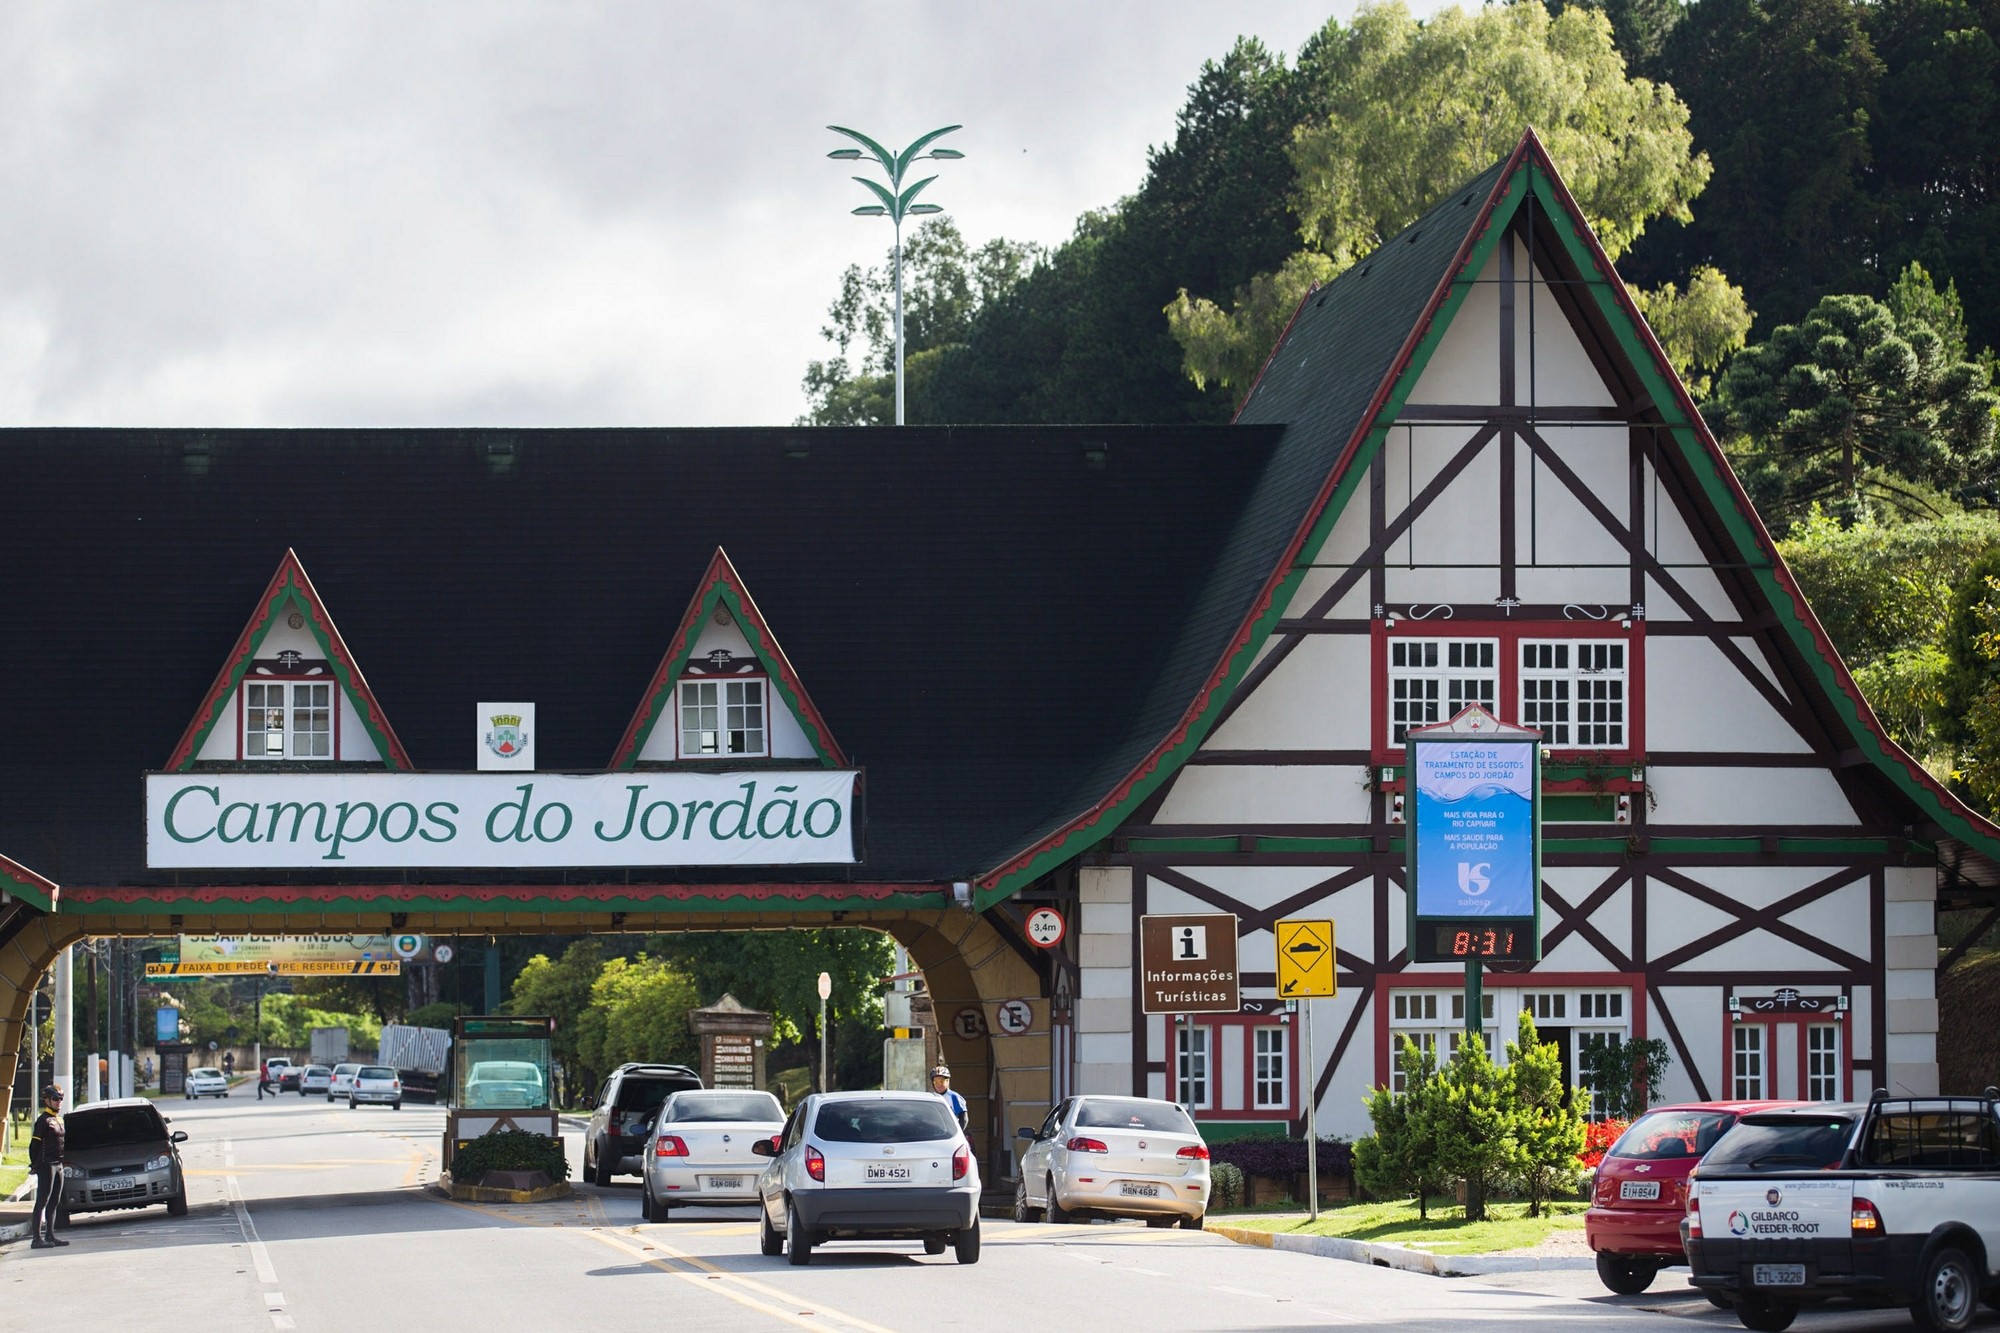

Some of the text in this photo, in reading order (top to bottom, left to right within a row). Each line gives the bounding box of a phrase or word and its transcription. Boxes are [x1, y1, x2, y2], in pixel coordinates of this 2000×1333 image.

[1450, 750, 1498, 760] ESTAÇÃO DE
[1424, 761, 1524, 769] TRATAMENTO DE ESGOTOS
[1434, 769, 1514, 780] CAMPOS DO JORDÃO
[1444, 811, 1505, 819] MAIS VIDA PARA O
[163, 781, 842, 860] Campos do Jordão
[1452, 820, 1496, 828] RIO CAPIVARI
[1457, 841, 1498, 852] POPULAÇÃO
[1458, 898, 1491, 907] sabesp
[1034, 923, 1057, 933] 3,4m
[1453, 931, 1514, 955] 8:31
[183, 963, 212, 972] FAIXA
[217, 962, 231, 971] DE
[302, 962, 353, 971] RESPEITE
[1148, 969, 1234, 983] Informações
[1156, 990, 1227, 1003] Turísticas
[1885, 1181, 1945, 1191] www.gilbarco.com.br
[1751, 1211, 1799, 1222] GILBARCO
[1752, 1223, 1820, 1234] VEEDER-ROOT
